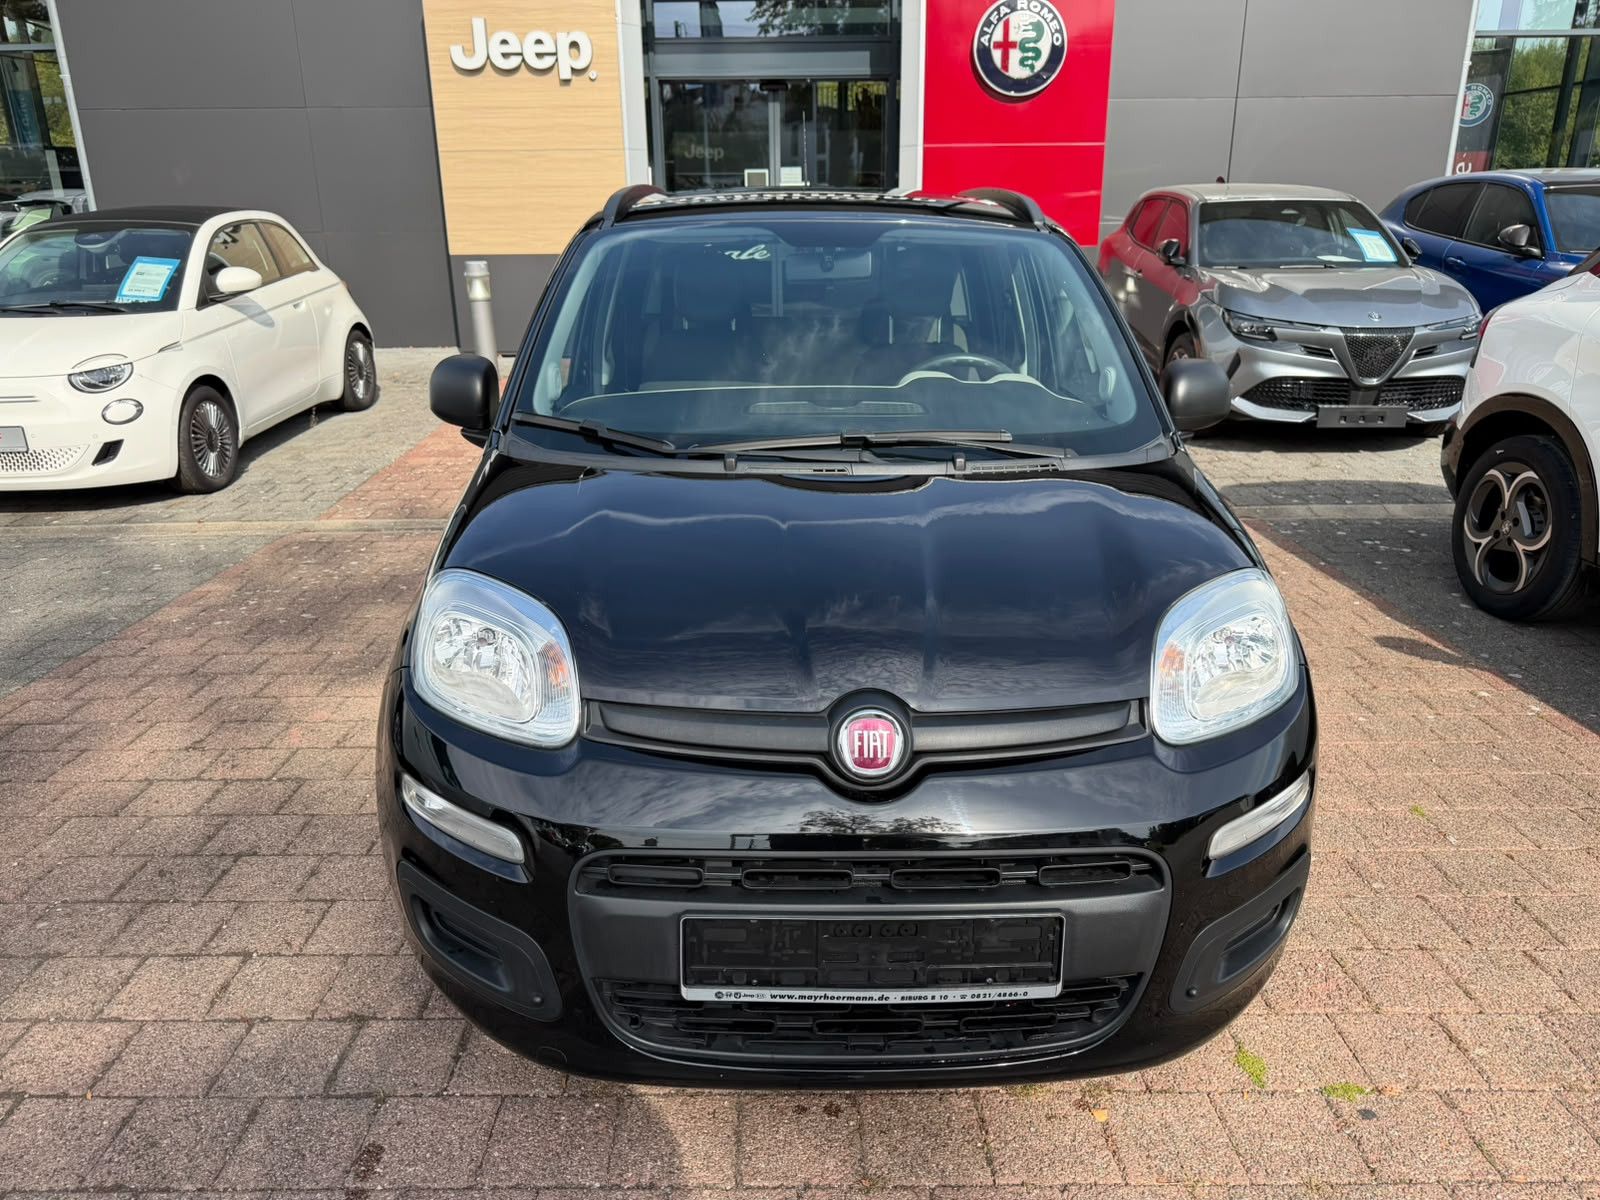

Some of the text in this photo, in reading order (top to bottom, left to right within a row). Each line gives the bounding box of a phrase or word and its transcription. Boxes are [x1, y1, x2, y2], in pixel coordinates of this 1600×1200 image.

[980, 0, 1062, 47] ALFA ROMEO
[449, 16, 593, 80] Jeep
[684, 143, 724, 161] Jeep
[853, 729, 890, 759] FIAT
[770, 992, 890, 1002] www.mayrhoermann.de
